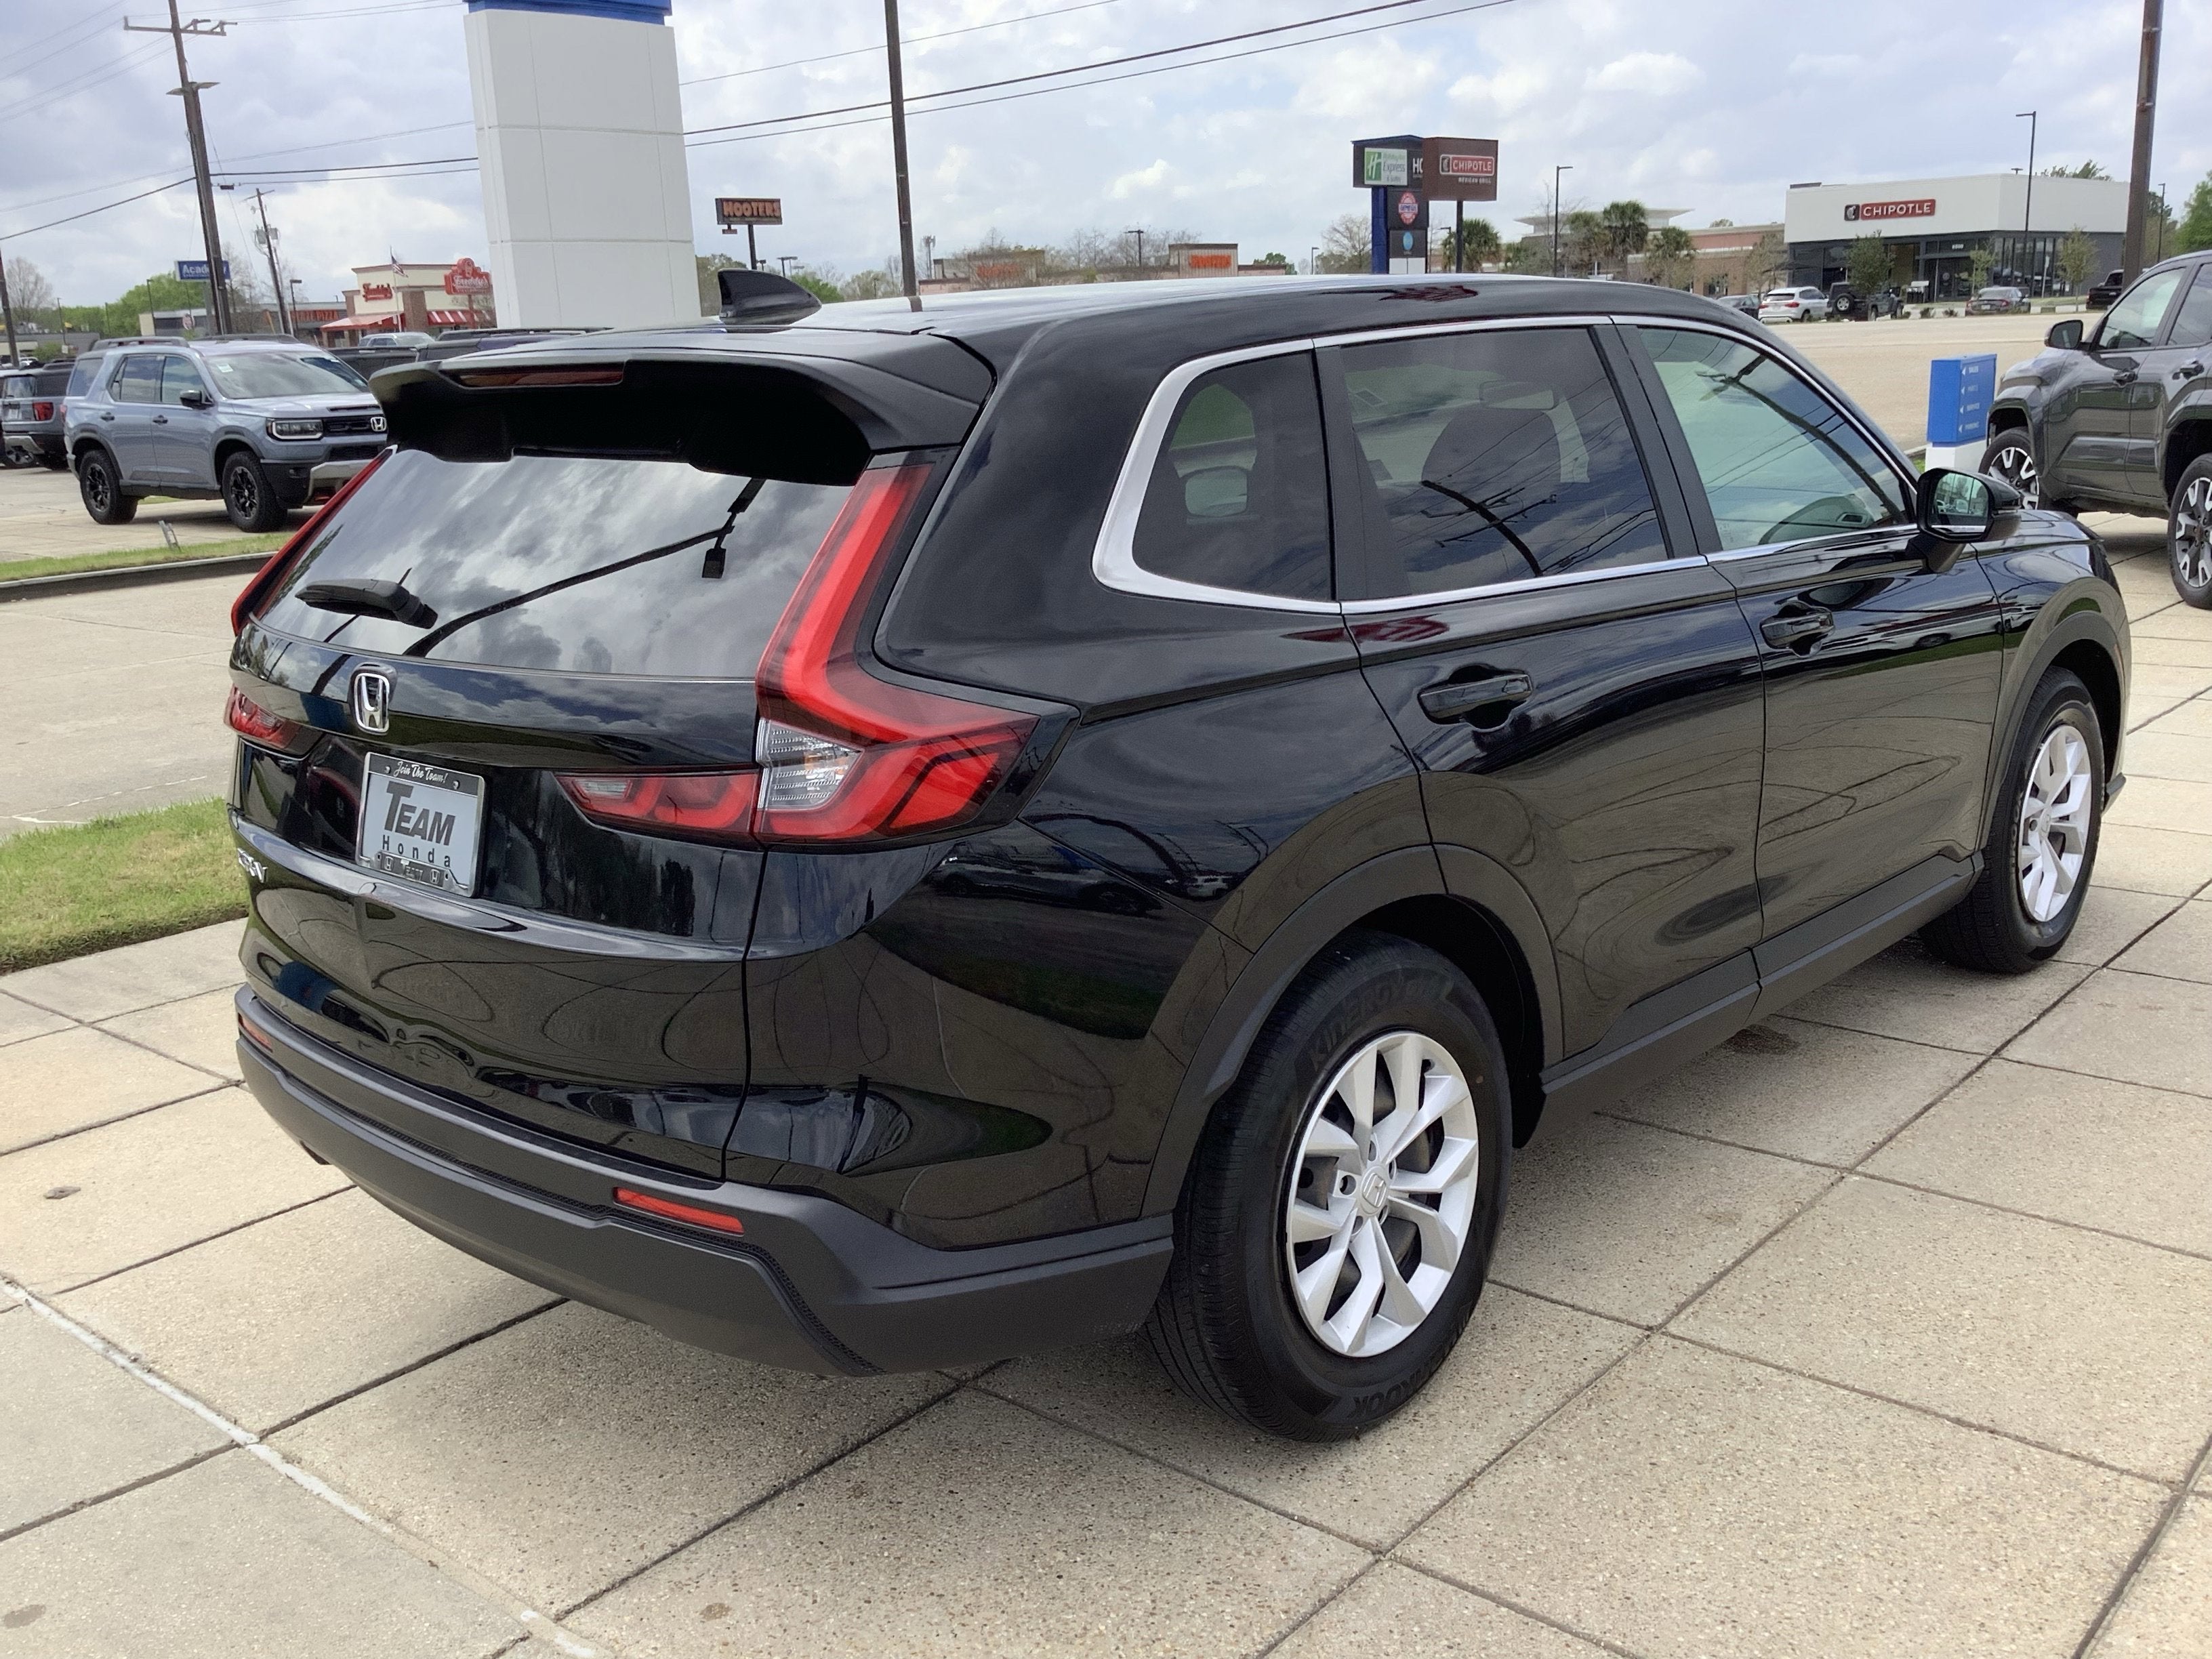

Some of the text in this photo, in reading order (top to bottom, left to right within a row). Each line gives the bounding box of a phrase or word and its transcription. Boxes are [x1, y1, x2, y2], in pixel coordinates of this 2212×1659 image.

[1383, 162, 1406, 173] Express
[1452, 160, 1492, 171] CHIPOTLE
[722, 201, 780, 217] HOOTERS
[1863, 203, 1931, 217] CHIPOTLE
[393, 760, 449, 783] Join The Team!
[384, 781, 456, 846] TEAM
[382, 834, 451, 868] Honda
